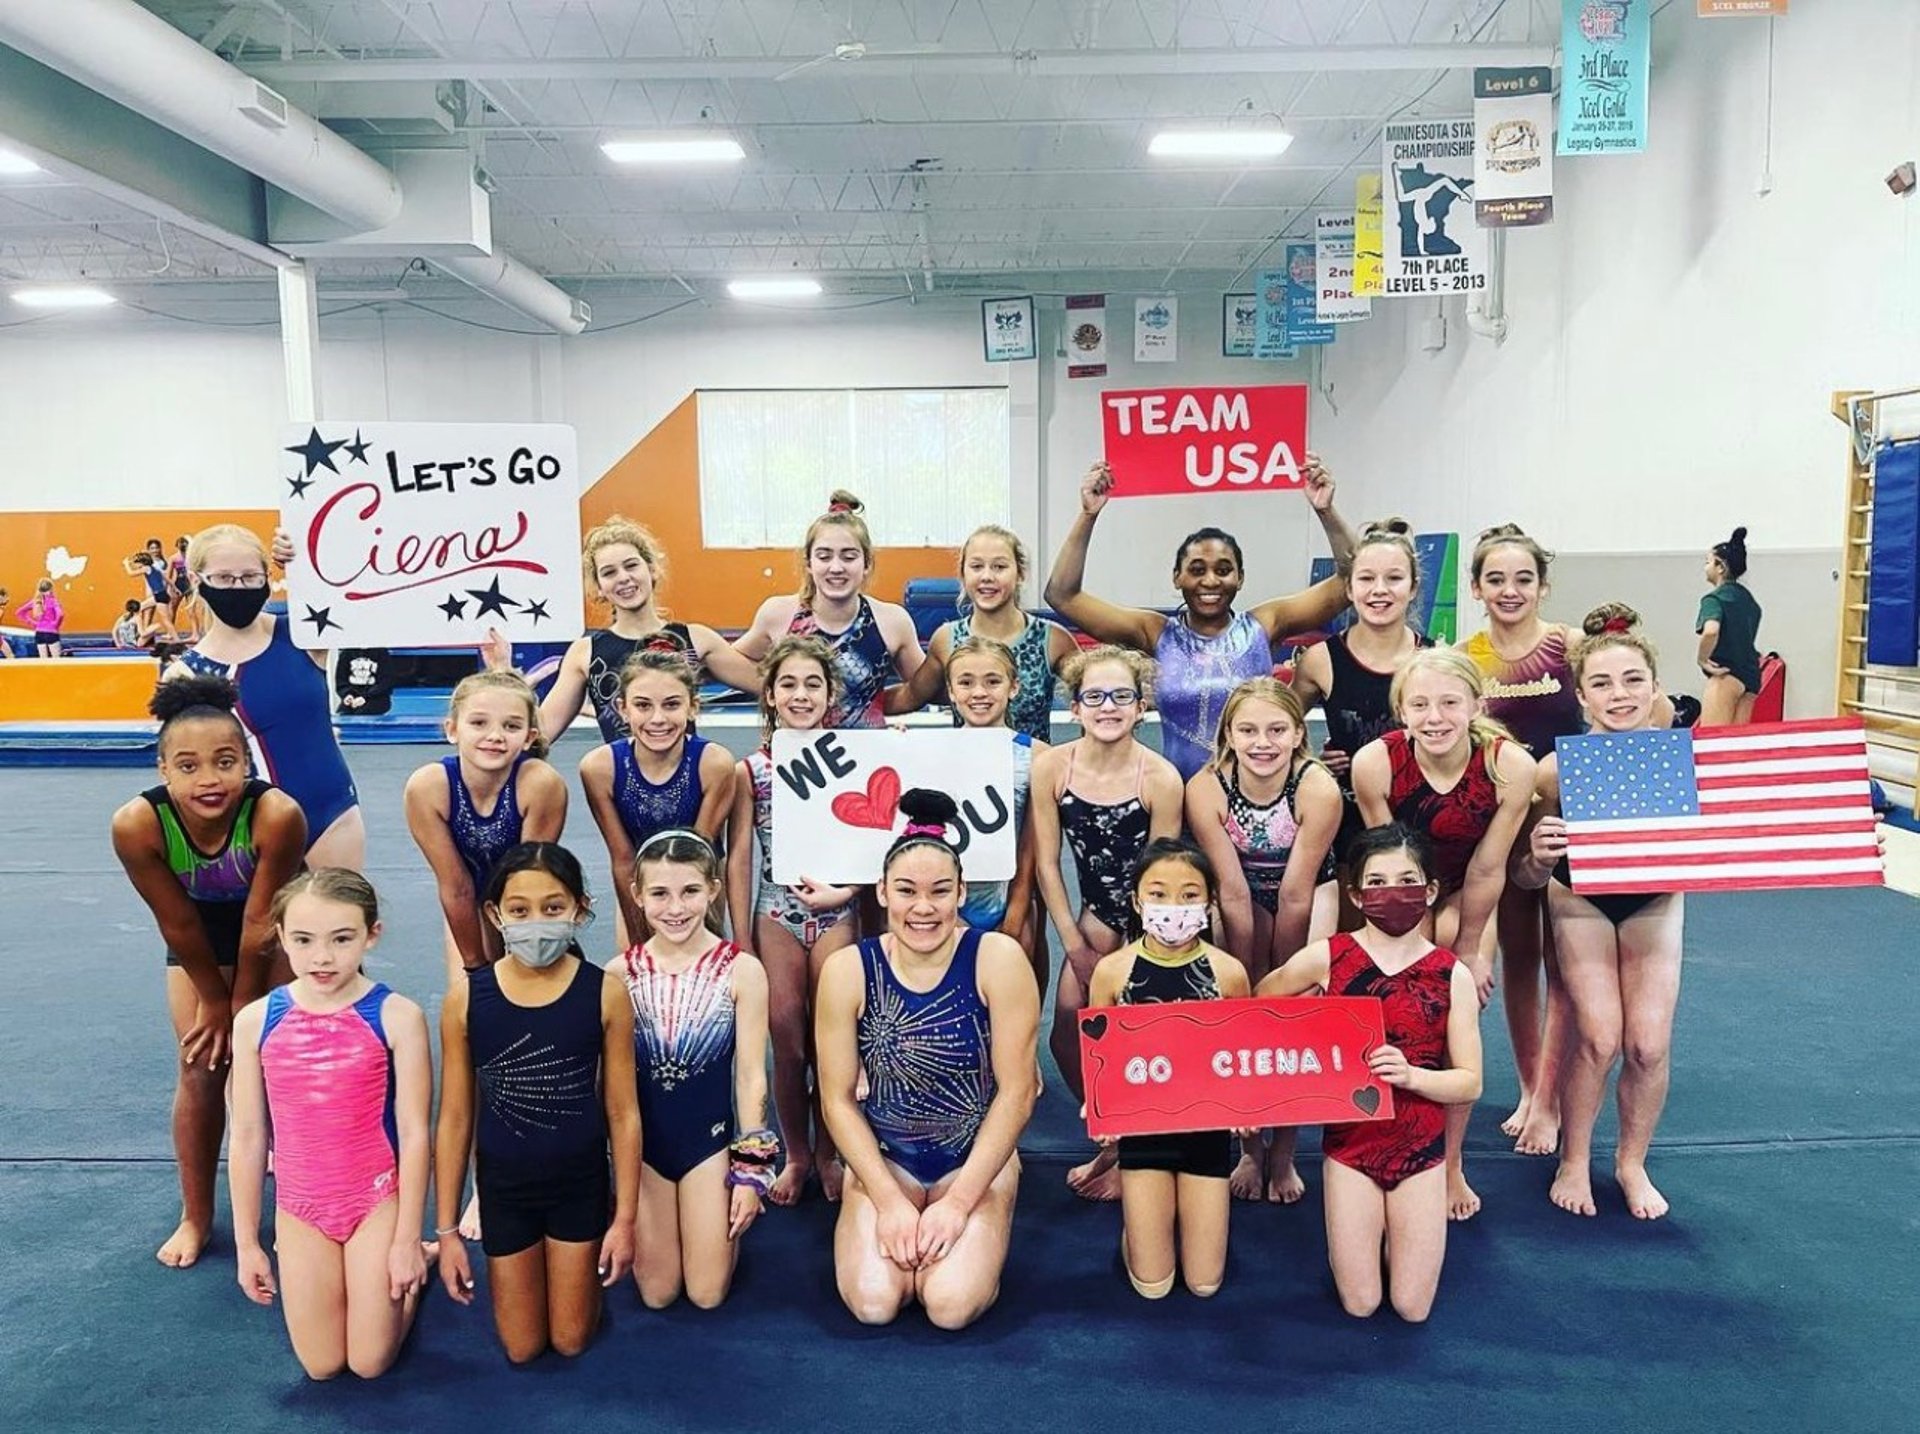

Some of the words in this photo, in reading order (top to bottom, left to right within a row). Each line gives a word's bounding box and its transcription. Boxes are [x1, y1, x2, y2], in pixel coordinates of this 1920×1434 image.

[1578, 50, 1599, 79] 3rd
[1600, 50, 1629, 78] Place
[1485, 79, 1523, 91] Level
[1529, 76, 1539, 88] 6
[1578, 95, 1601, 119] Xcel
[1602, 92, 1627, 118] Gold
[1386, 123, 1449, 142] MINNESOTA
[1451, 121, 1475, 139] STAT
[1571, 121, 1597, 133] January
[1567, 138, 1593, 151] Legacy
[1594, 136, 1637, 149] Gymnastics
[1483, 203, 1516, 213] Fourth
[1517, 201, 1545, 211] Place
[1501, 212, 1527, 221] Team
[1318, 216, 1355, 228] Level
[1402, 261, 1422, 275] 7th
[1426, 257, 1469, 274] PLACE
[1386, 278, 1426, 293] LEVEL
[1430, 277, 1438, 290] 5
[1453, 274, 1486, 290] 2013
[1323, 289, 1354, 300] Plac
[1107, 393, 1251, 436] TEAM
[386, 450, 497, 493] LET'S
[508, 447, 561, 485] GO
[1184, 441, 1301, 487] USA
[307, 482, 528, 587] Ciena
[776, 731, 857, 801] WE
[1124, 1055, 1173, 1085] GO
